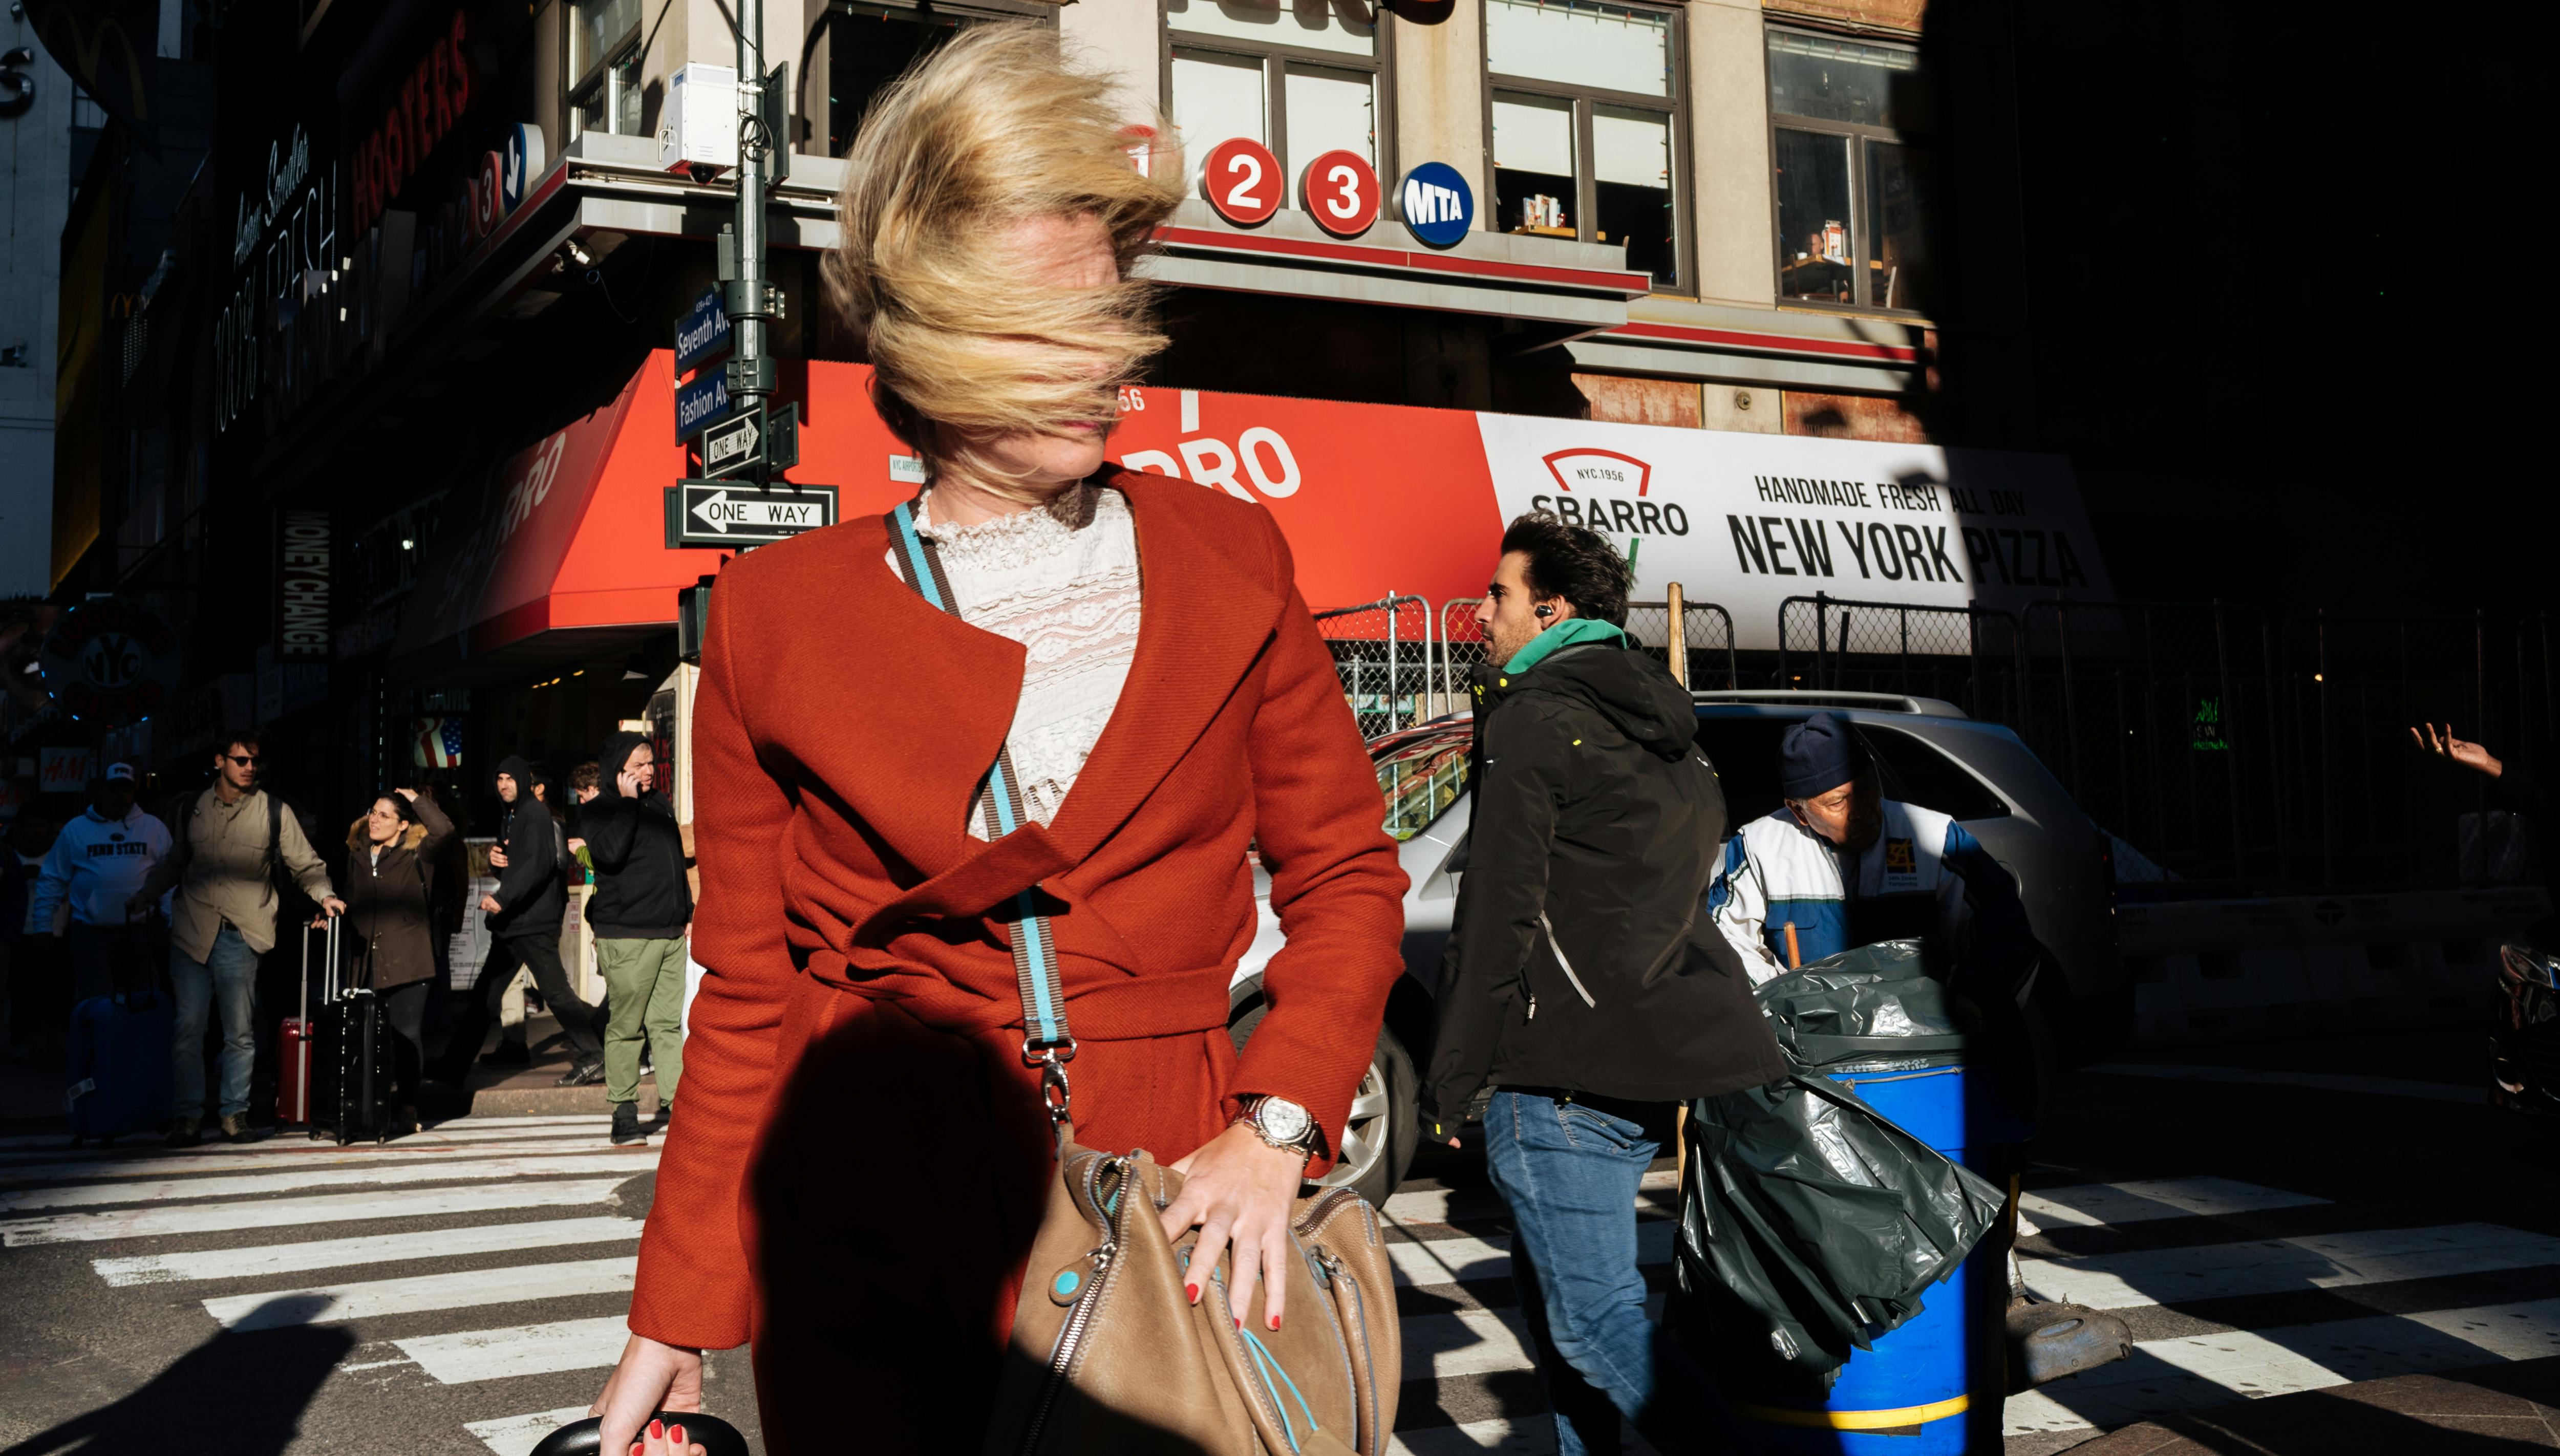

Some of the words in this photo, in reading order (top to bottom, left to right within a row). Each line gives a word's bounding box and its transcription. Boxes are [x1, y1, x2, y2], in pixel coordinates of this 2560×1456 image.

[351, 8, 470, 241] HOOTERS
[482, 167, 492, 223] 3
[1227, 154, 1261, 209] 2
[1327, 165, 1361, 219] 3
[1405, 179, 1463, 225] MTA
[214, 265, 257, 438] 100%
[678, 313, 713, 360] Seventh
[680, 390, 713, 428] Fashion
[715, 380, 730, 409] Av
[714, 437, 729, 460] ONE
[736, 427, 753, 451] WAY
[1577, 468, 1624, 482] NYC.1956
[1754, 476, 1871, 508] HANDMADE
[1876, 483, 1942, 511] FRESH
[1949, 487, 1986, 514] ALL
[1989, 489, 2026, 517] DAY
[709, 503, 748, 521] ONE
[768, 505, 810, 523] WAY
[1531, 495, 1689, 537] SBARRO
[284, 509, 330, 576] MONEY
[1726, 514, 1834, 577] NEW
[1836, 521, 1965, 583] YORK
[1962, 526, 2088, 588] PIZZA
[283, 578, 330, 656] CHANGE
[85, 635, 140, 684] NYC
[44, 755, 87, 782] H&M
[87, 844, 114, 859] PENN
[116, 842, 147, 855] STATE
